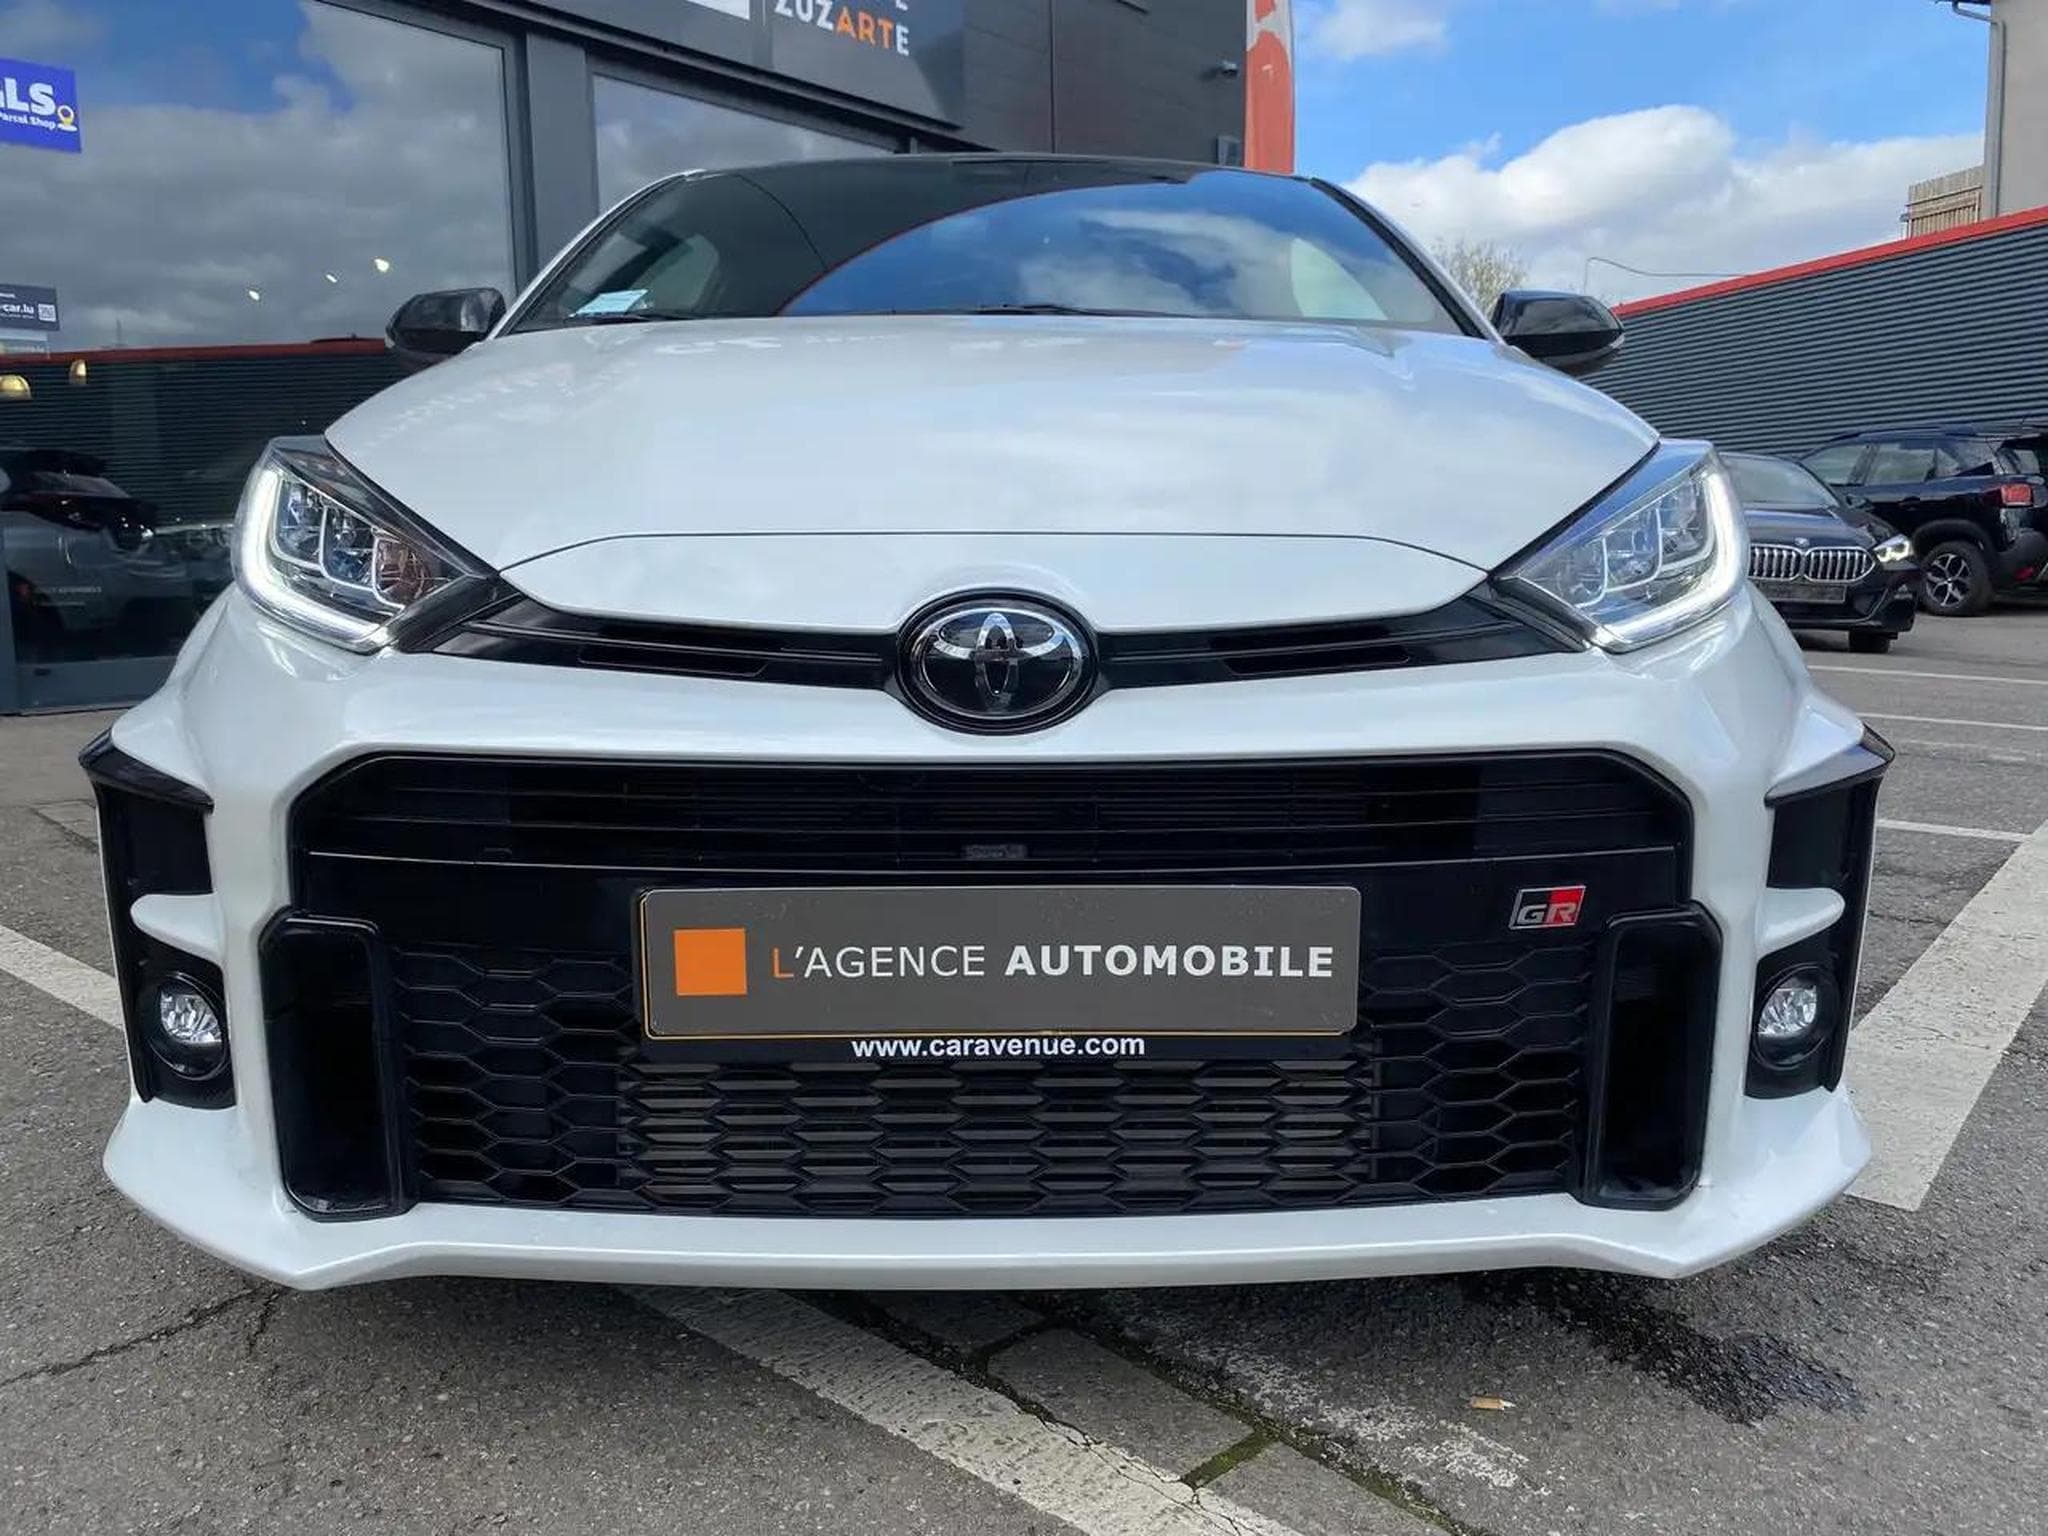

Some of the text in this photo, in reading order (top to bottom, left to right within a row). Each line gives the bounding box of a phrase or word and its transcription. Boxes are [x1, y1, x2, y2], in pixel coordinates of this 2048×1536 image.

[0, 77, 56, 116] LS
[29, 116, 56, 130] Shop
[1516, 903, 1578, 924] GR
[772, 944, 1333, 979] L'AGENCE AUTOMOBILE
[851, 1036, 1145, 1057] www.caravenue.com
